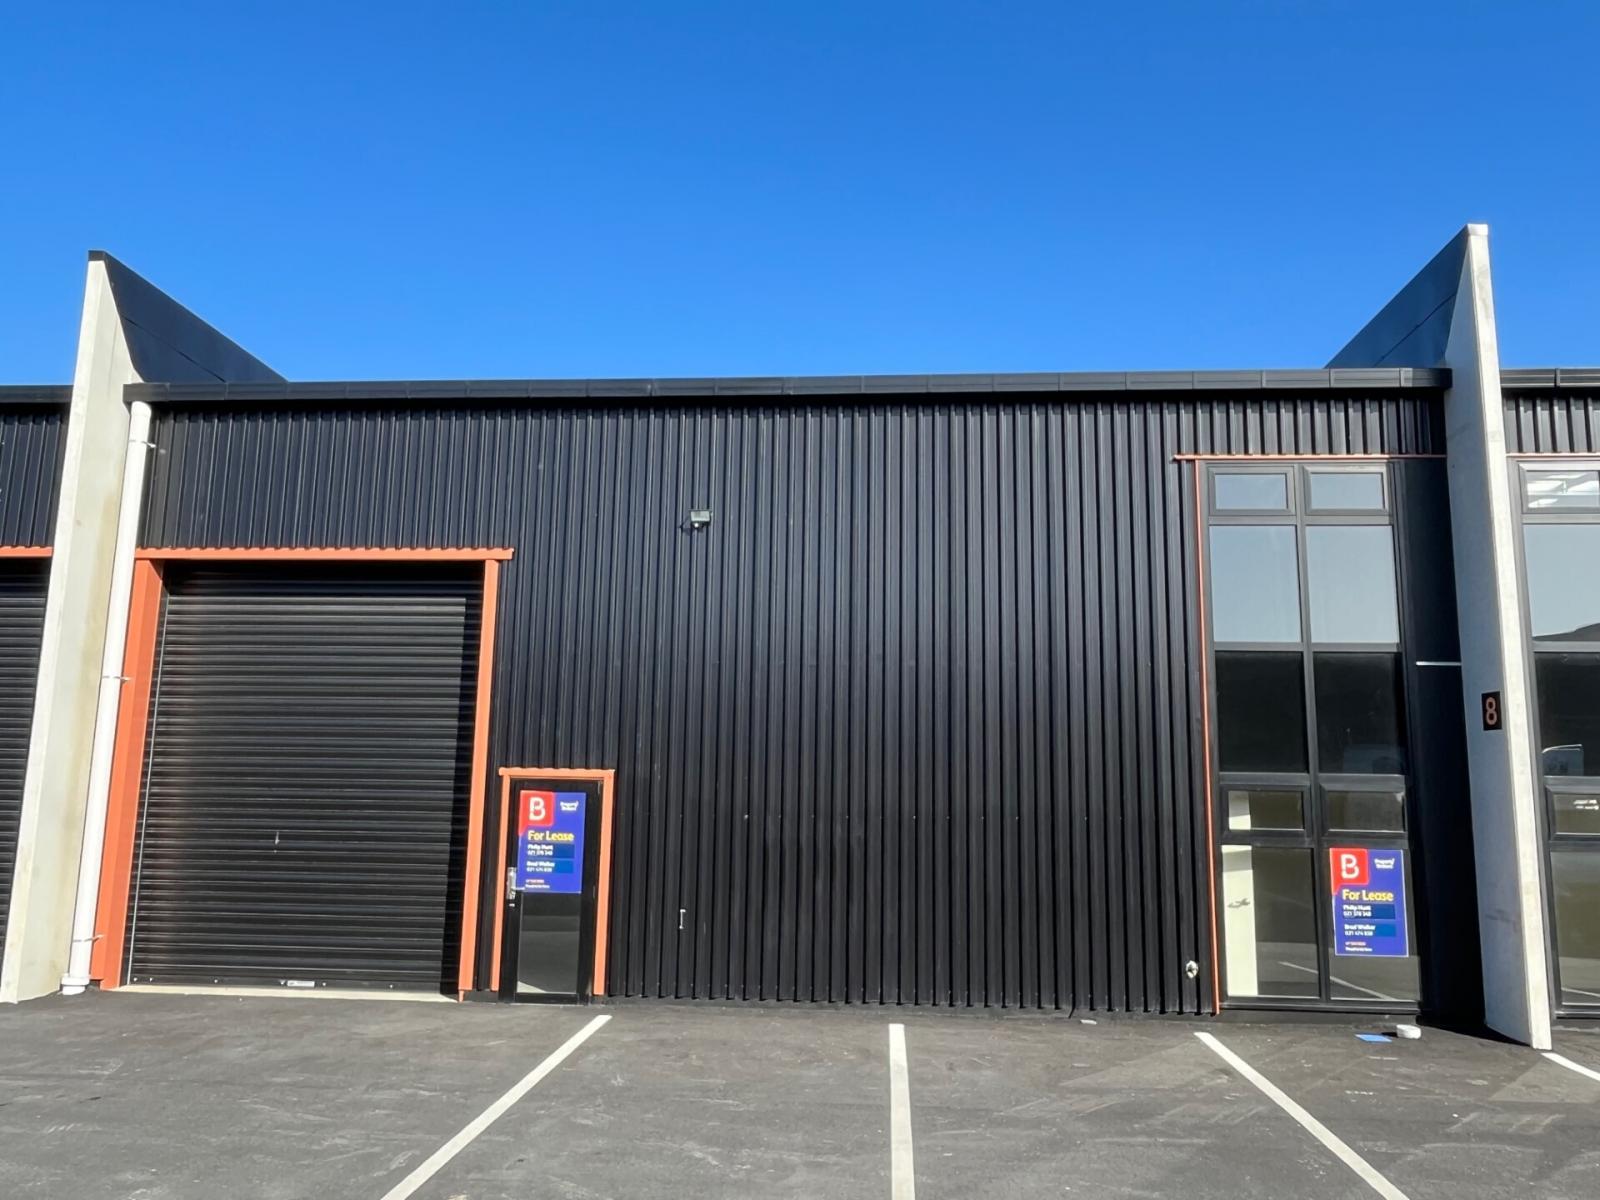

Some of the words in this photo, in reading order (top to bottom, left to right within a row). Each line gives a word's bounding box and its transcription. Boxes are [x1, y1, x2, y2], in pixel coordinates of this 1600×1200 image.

[1486, 697, 1497, 725] 8
[528, 797, 546, 821] B
[527, 830, 544, 841] For
[545, 831, 575, 841] Lease
[1341, 854, 1360, 879] B
[1342, 889, 1361, 900] For
[1362, 890, 1394, 902] Lease
